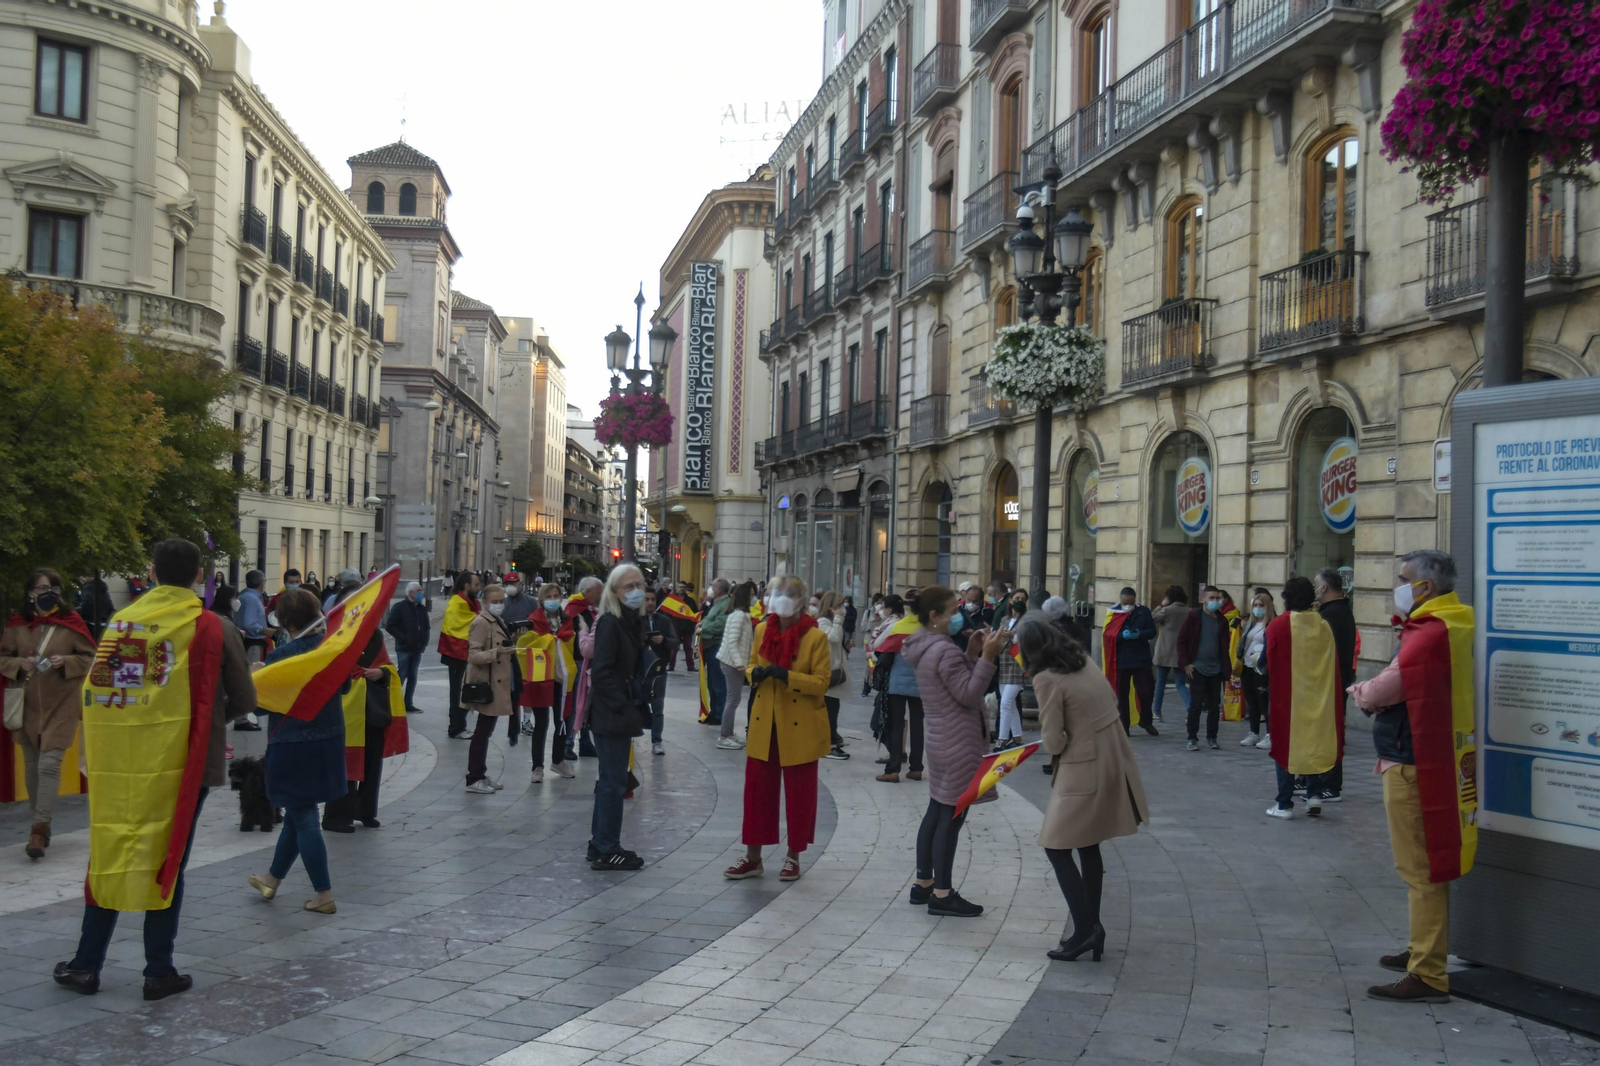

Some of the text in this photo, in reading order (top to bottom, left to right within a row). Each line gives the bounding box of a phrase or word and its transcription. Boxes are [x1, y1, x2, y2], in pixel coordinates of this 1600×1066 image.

[691, 299, 701, 326] Blanco
[688, 326, 701, 378] Blanco
[695, 331, 715, 408] Blanco
[687, 378, 696, 412] Blanco
[701, 411, 712, 446] Blanco
[1496, 441, 1552, 458] PROTOCOLO
[1554, 440, 1567, 454] DE
[1321, 456, 1356, 488] BURGER
[1499, 459, 1534, 475] FRENTE
[1537, 458, 1550, 472] AL
[1177, 472, 1206, 498] BURGER
[1177, 485, 1206, 516] KING
[1322, 471, 1356, 510] KING
[1568, 643, 1596, 652] MEDIDAS
